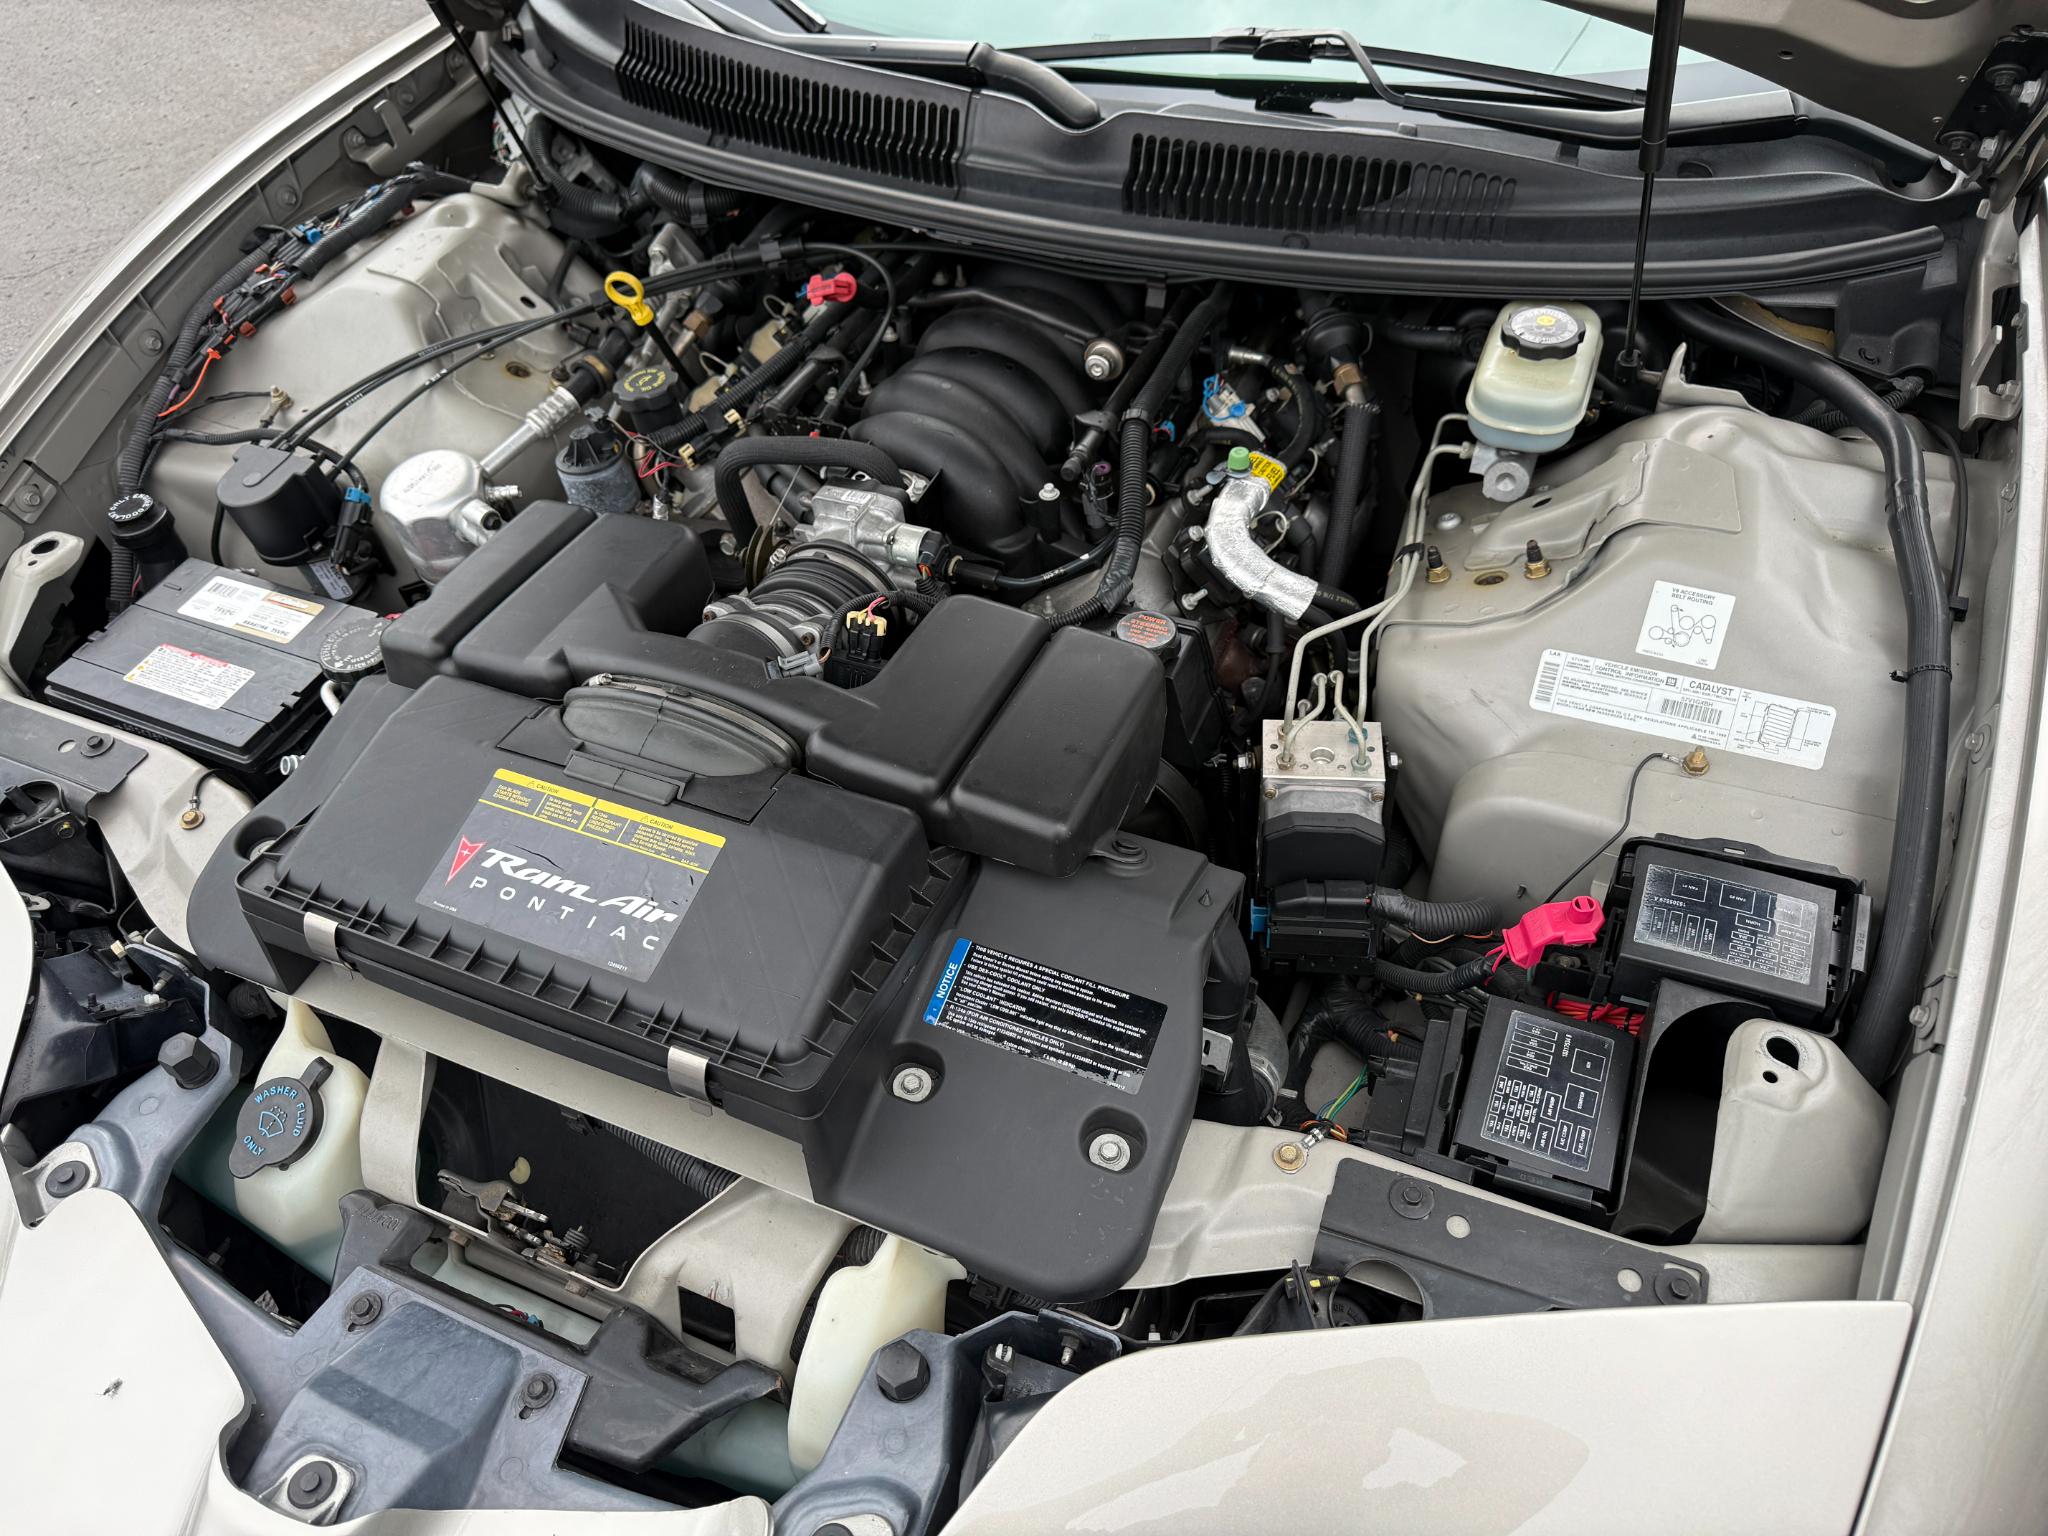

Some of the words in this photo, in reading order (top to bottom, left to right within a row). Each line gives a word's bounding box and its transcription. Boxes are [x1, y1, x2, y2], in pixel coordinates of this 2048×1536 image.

[109, 495, 130, 510] ONLY
[1680, 589, 1715, 599] ACCESSORY
[1686, 595, 1712, 605] ROUTING
[1131, 619, 1168, 631] STEERING
[1138, 614, 1167, 624] POWER
[1594, 665, 1621, 674] CONTROL
[1625, 671, 1664, 683] INFORMATION
[1604, 662, 1628, 670] VEHICLE
[1629, 667, 1657, 676] EMISSION
[1689, 680, 1733, 695] CATALYST
[536, 783, 558, 793] CAUTION
[649, 818, 673, 829] CAUTION
[481, 848, 597, 903] Ram
[599, 896, 679, 922] Air
[470, 876, 658, 949] PONTIAC
[936, 962, 957, 998] NOTICE
[987, 949, 1007, 959] VEHICLE
[1007, 956, 1033, 967] REQUIRES
[1038, 965, 1058, 976] SPECIAL
[1060, 973, 1085, 984] COOLANT
[1097, 985, 1129, 999] PROCEDURE
[1006, 976, 1031, 987] COOLANT
[1031, 984, 1045, 992] ONLY
[999, 999, 1025, 1011] INDICATOR
[988, 1017, 1023, 1033] CONDITIONED
[1023, 1030, 1048, 1042] VEHICLES
[254, 1085, 298, 1104] WASHER
[292, 1102, 305, 1137] FLUID
[243, 1135, 265, 1156] ONLY
